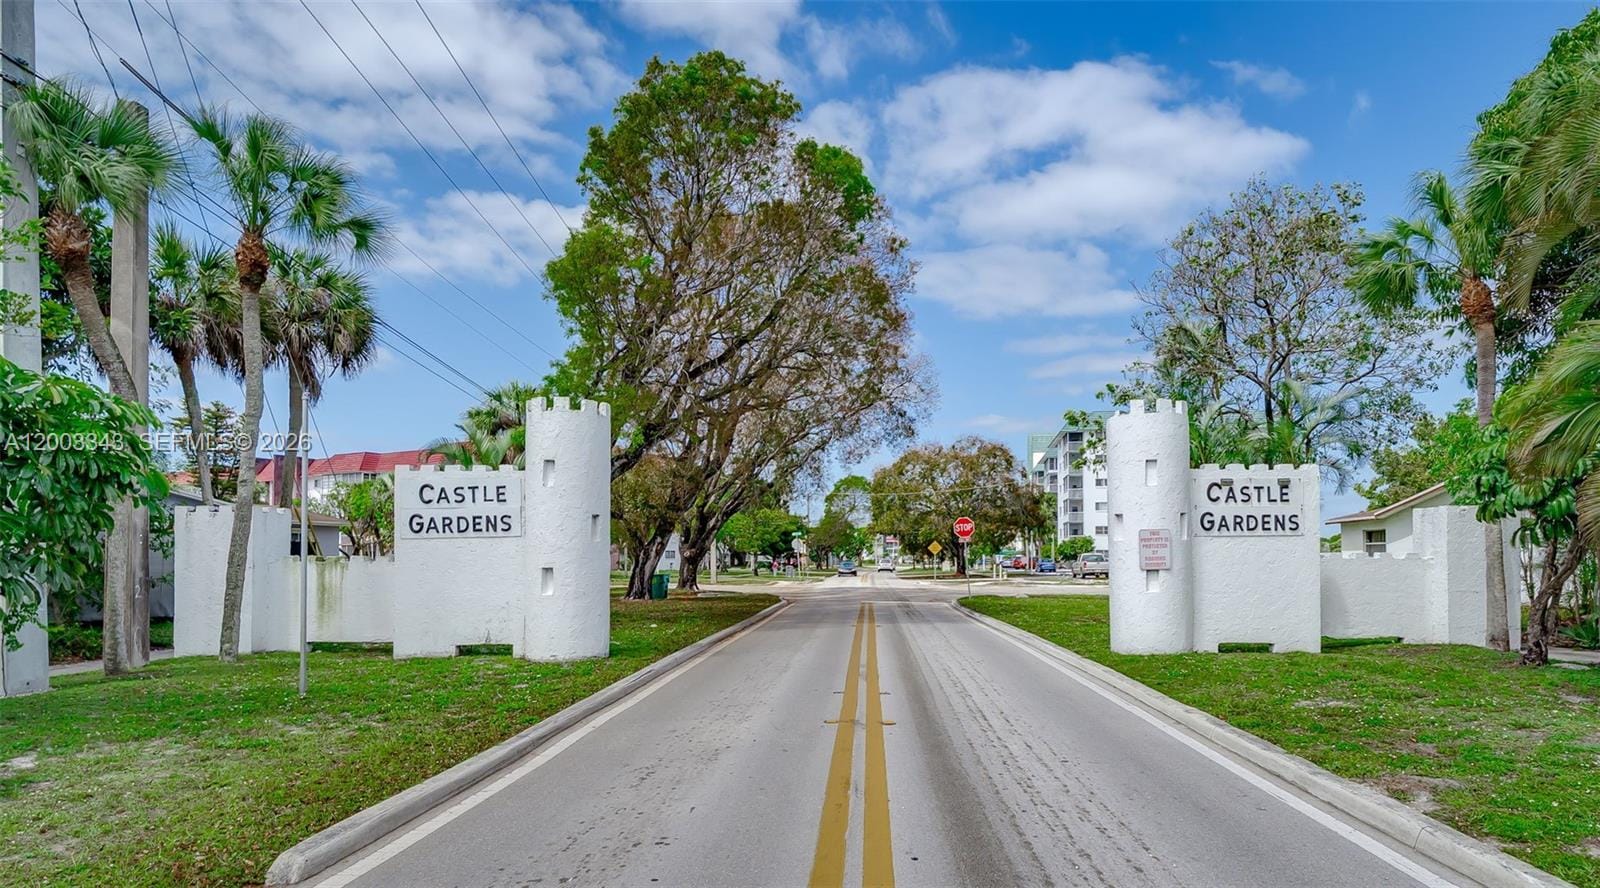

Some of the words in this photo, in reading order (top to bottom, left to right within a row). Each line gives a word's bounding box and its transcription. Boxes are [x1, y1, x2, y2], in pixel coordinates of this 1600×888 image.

[419, 483, 507, 504] CASTLE
[1206, 482, 1291, 503] CASTLE
[408, 513, 512, 534] GARDENS
[955, 523, 973, 532] STOP
[1199, 511, 1300, 532] GARDENS
